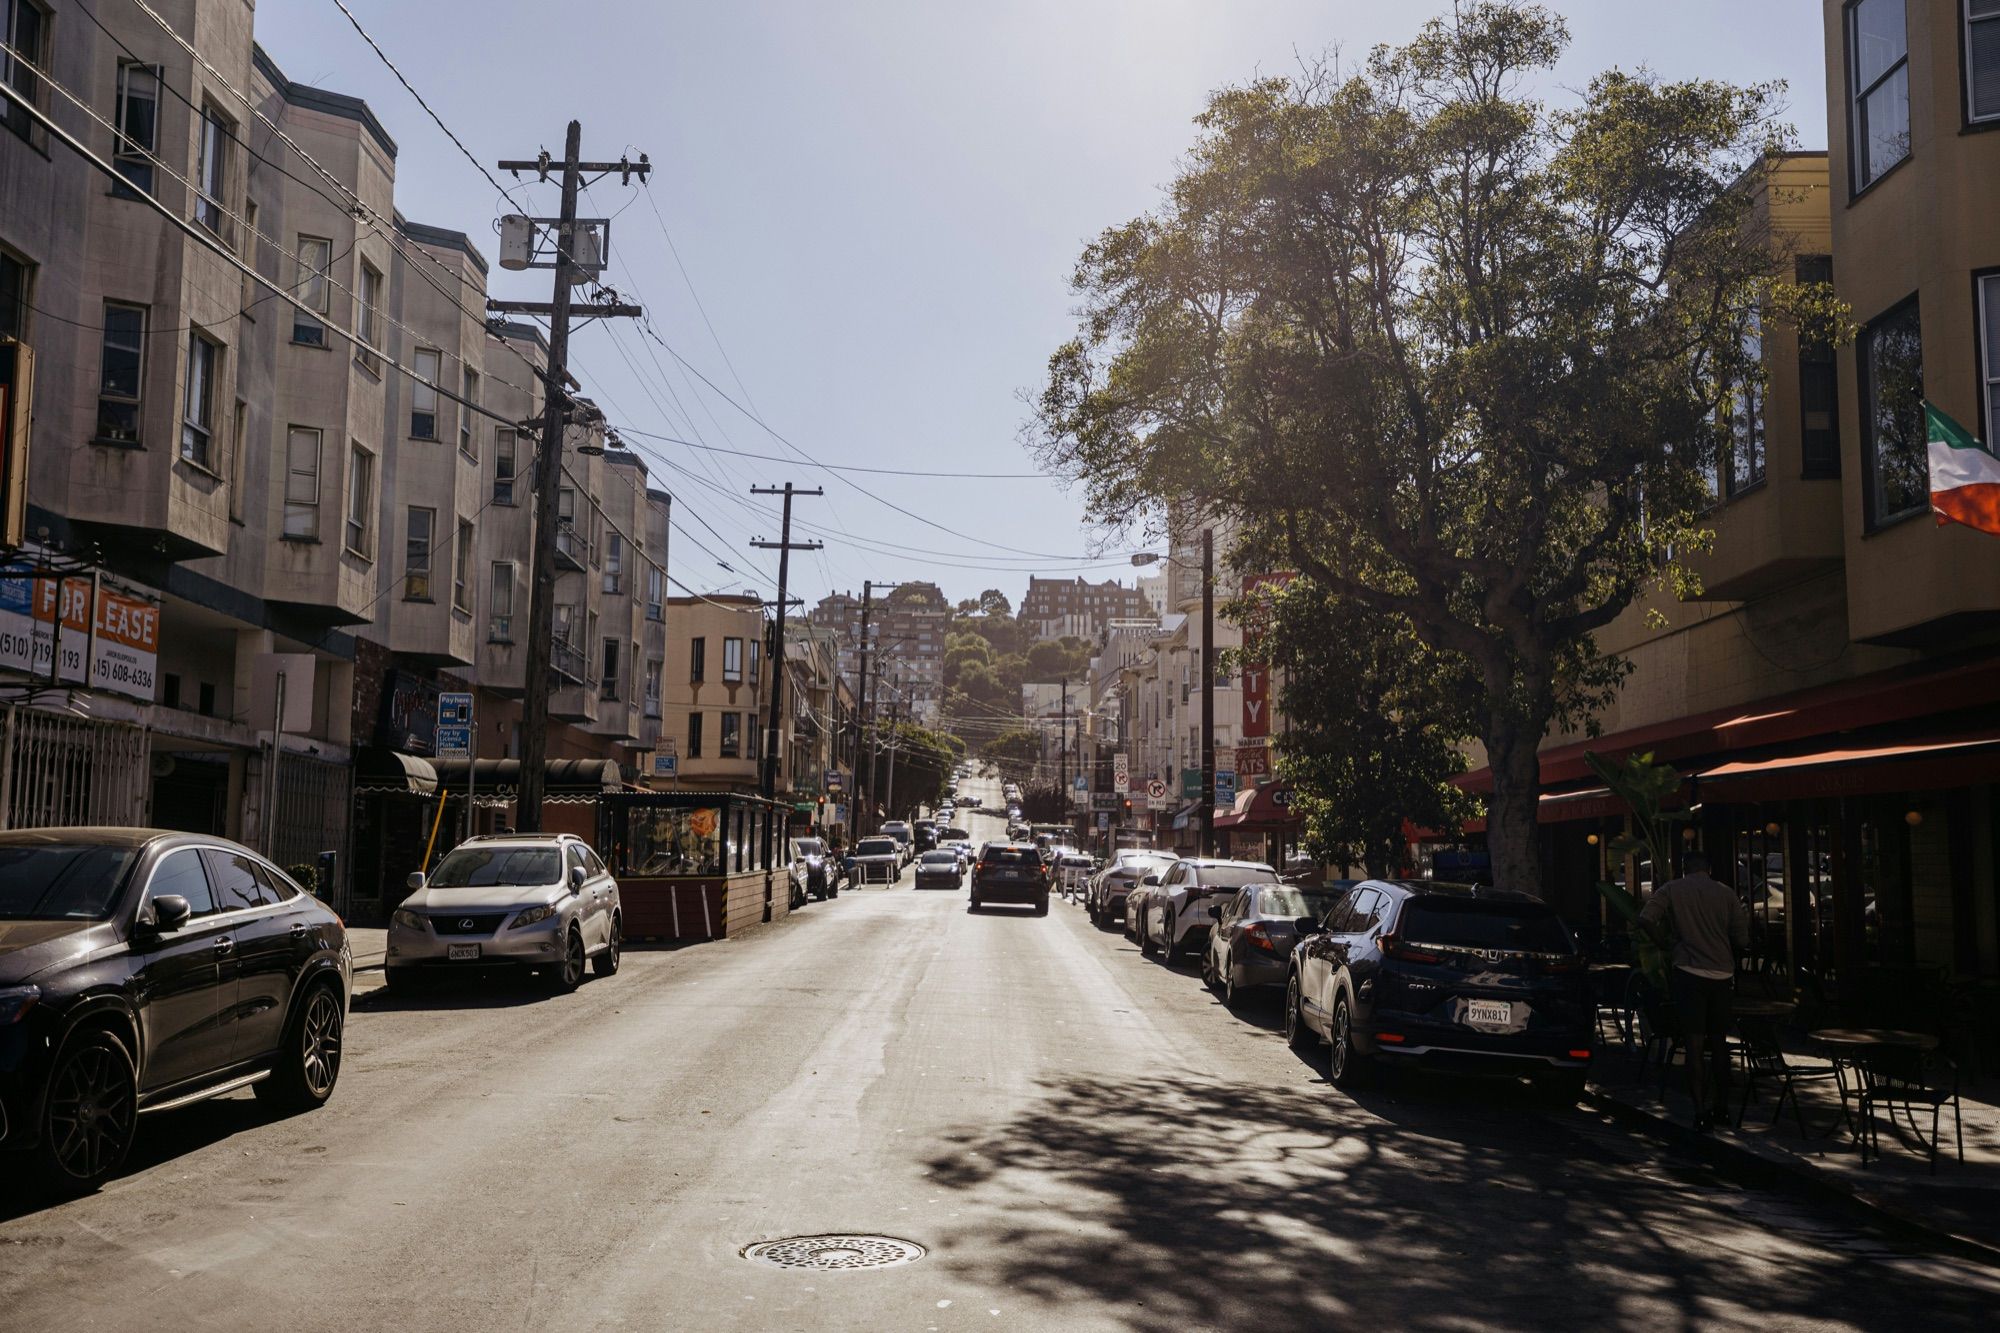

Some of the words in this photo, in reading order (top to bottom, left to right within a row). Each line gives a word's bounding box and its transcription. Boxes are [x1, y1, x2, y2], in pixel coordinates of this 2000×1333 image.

[33, 641, 80, 670] 919-193
[112, 662, 152, 688] 608-6336
[441, 696, 454, 704] Pay
[454, 696, 469, 704] here
[1471, 1008, 1508, 1022] 9YNX817
